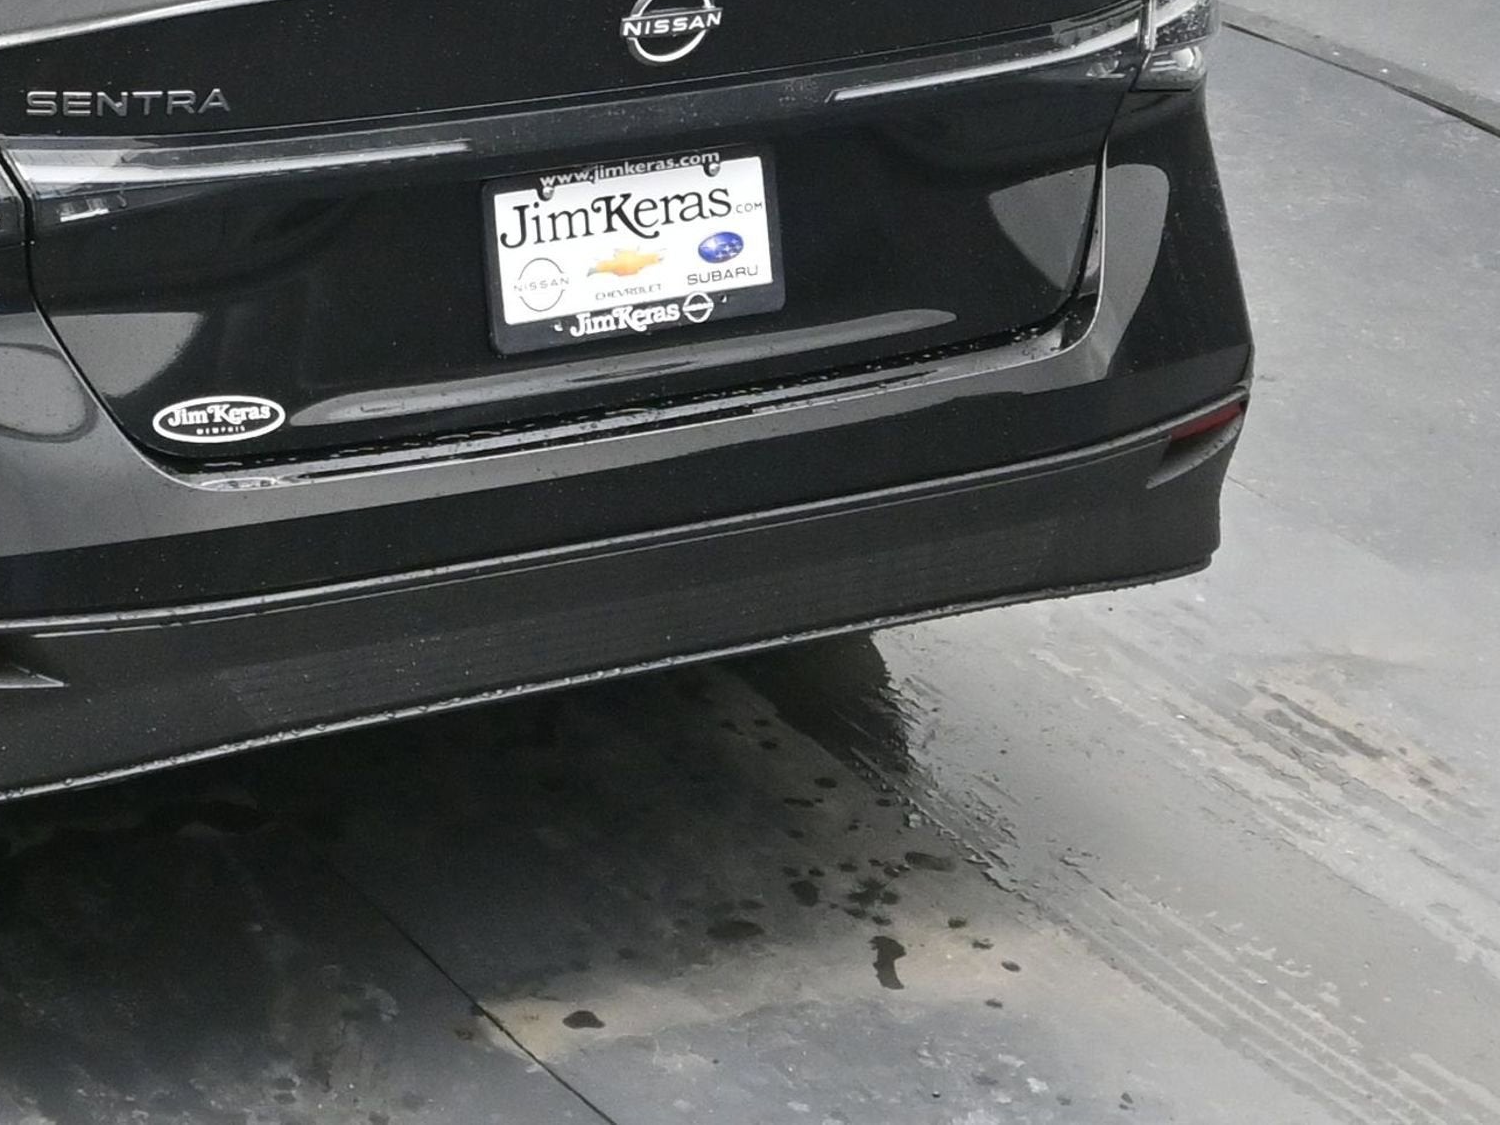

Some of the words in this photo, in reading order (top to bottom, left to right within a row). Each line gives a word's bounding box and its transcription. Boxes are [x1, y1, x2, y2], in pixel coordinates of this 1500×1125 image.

[623, 11, 722, 36] NISSAN
[26, 88, 230, 116] SENTRA
[540, 152, 720, 187] www.jimkeras.com
[513, 277, 570, 292] NISSAN
[687, 265, 759, 285] SUBARU
